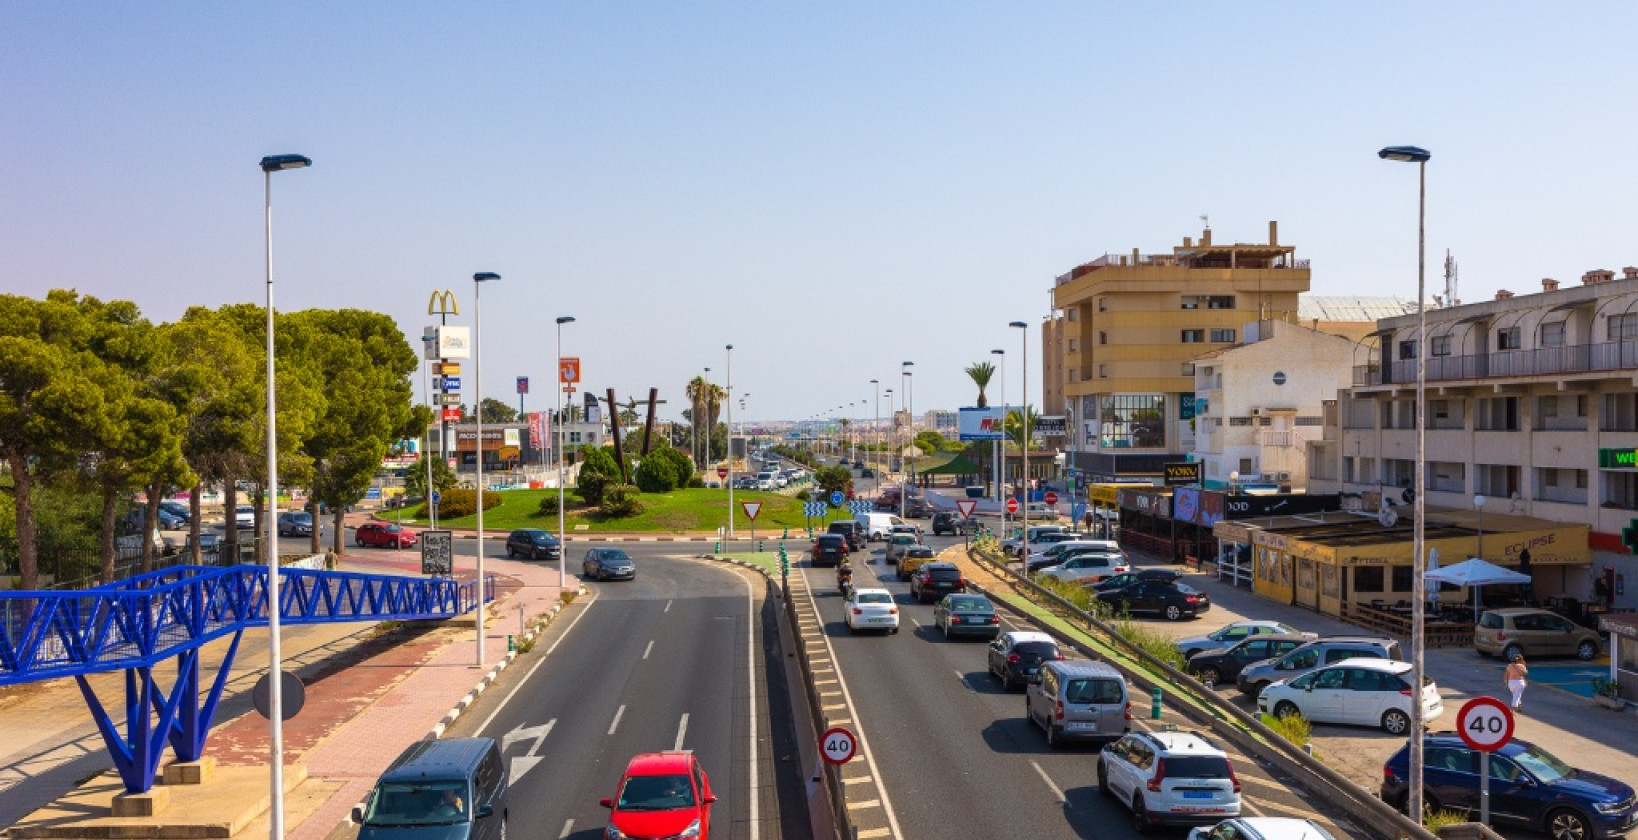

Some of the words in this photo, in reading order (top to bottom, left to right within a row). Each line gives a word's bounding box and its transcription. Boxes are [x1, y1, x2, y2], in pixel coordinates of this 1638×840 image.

[1504, 533, 1556, 556] ECLIPSE
[1469, 716, 1503, 734] 40
[827, 740, 849, 753] 40
